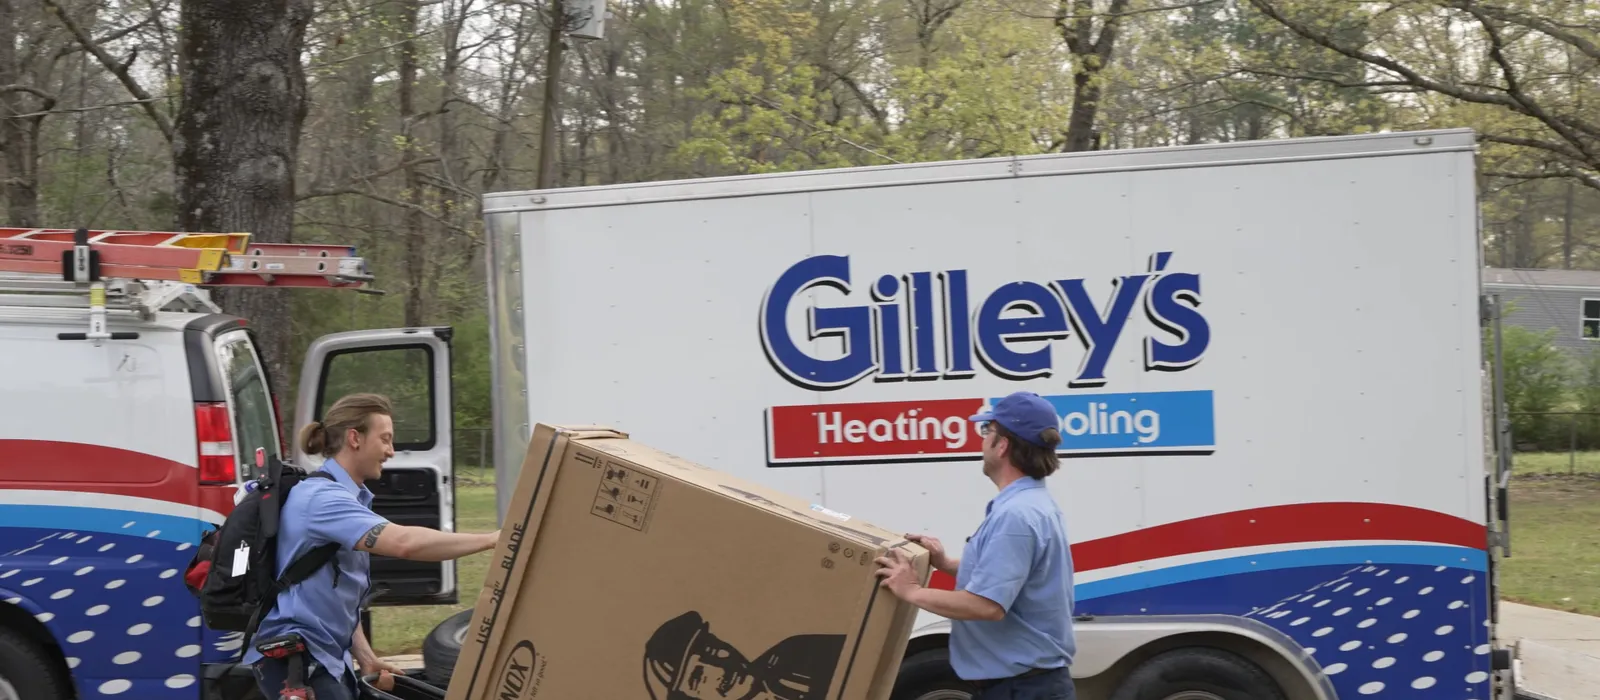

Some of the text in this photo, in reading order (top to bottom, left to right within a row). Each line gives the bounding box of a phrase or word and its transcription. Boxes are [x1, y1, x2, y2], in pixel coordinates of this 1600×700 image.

[759, 251, 1211, 391] Gilley's
[817, 405, 967, 449] Heating
[1058, 401, 1170, 443] oling
[476, 616, 492, 644] USE
[501, 523, 524, 570] BLADE
[499, 657, 530, 700] NOX
